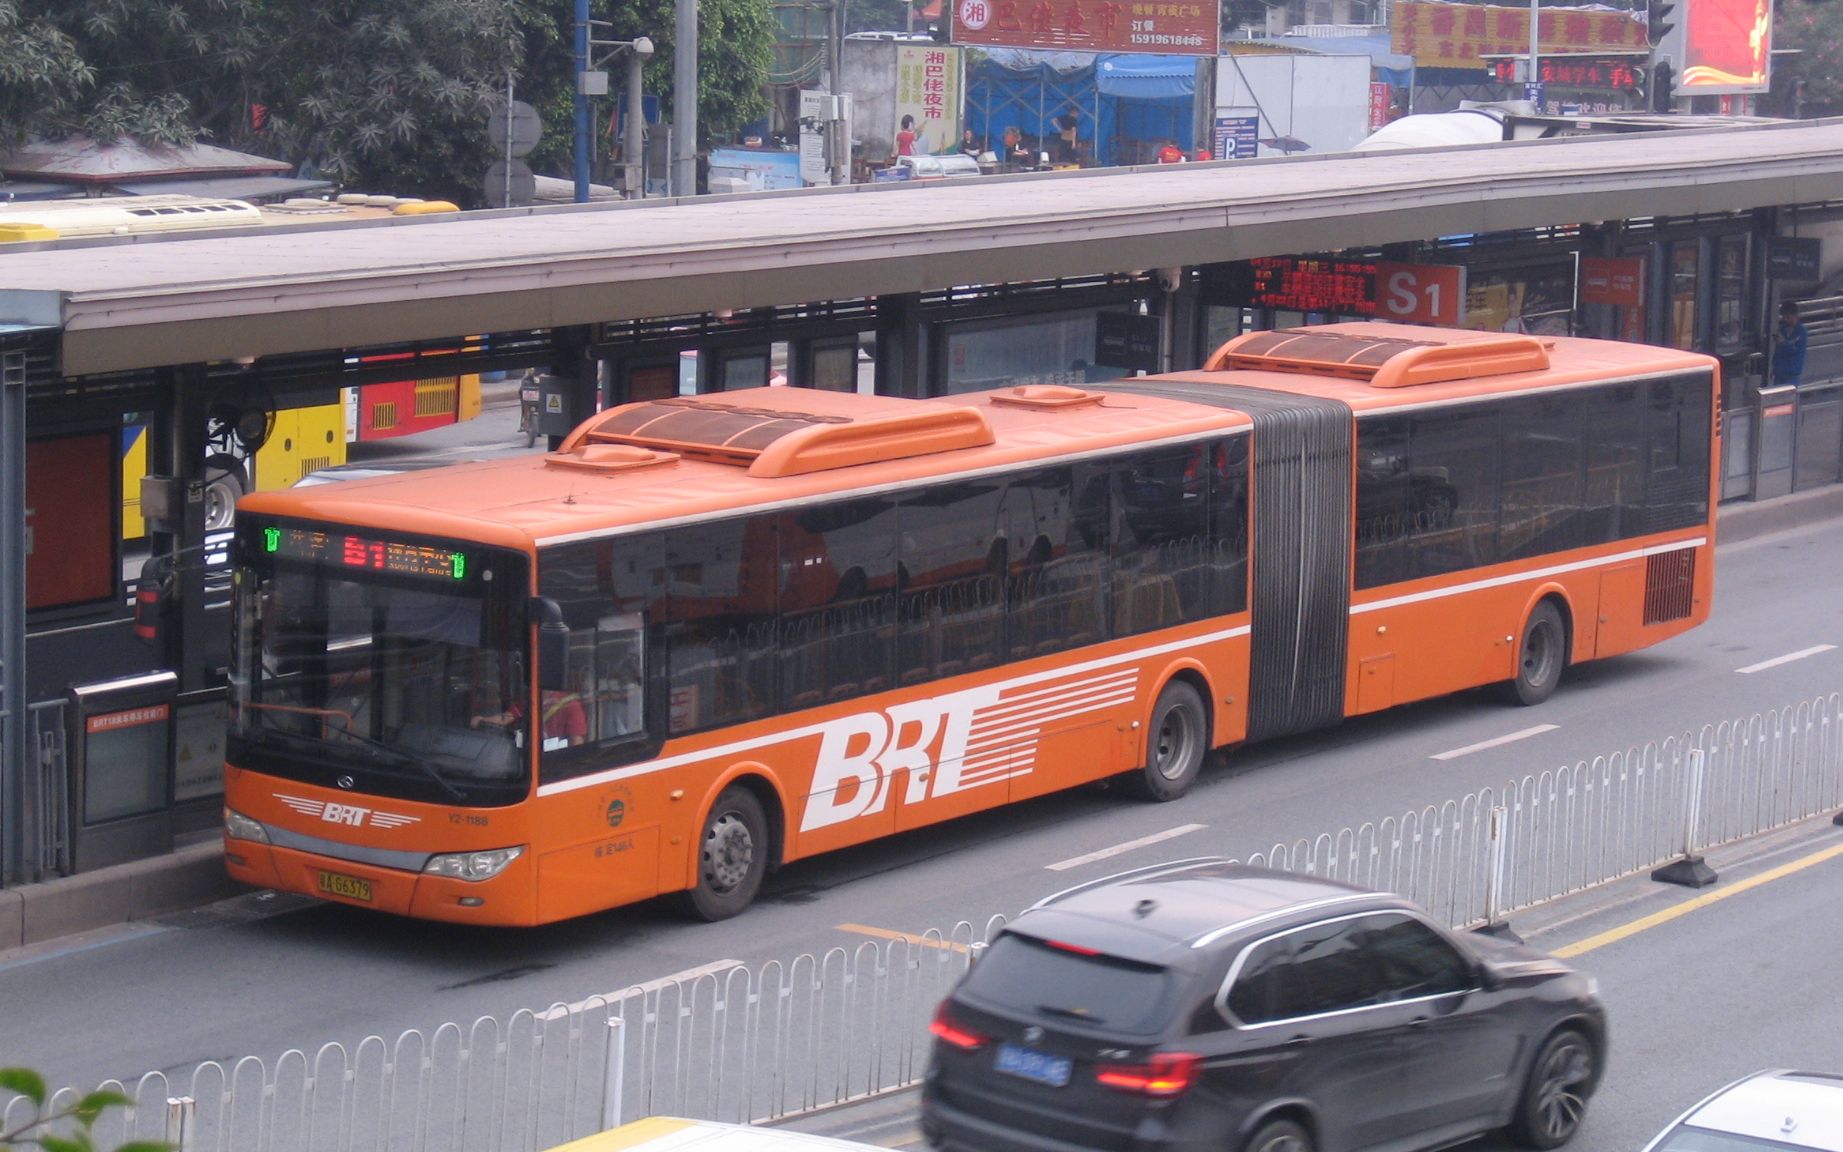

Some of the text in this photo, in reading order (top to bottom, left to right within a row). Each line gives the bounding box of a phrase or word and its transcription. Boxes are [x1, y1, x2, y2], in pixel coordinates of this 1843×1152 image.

[966, 1, 985, 22] 湘
[923, 51, 945, 119] 湘巴佬夜市
[1387, 271, 1440, 317] S1
[800, 682, 1001, 833] BRT
[321, 802, 371, 827] BRT
